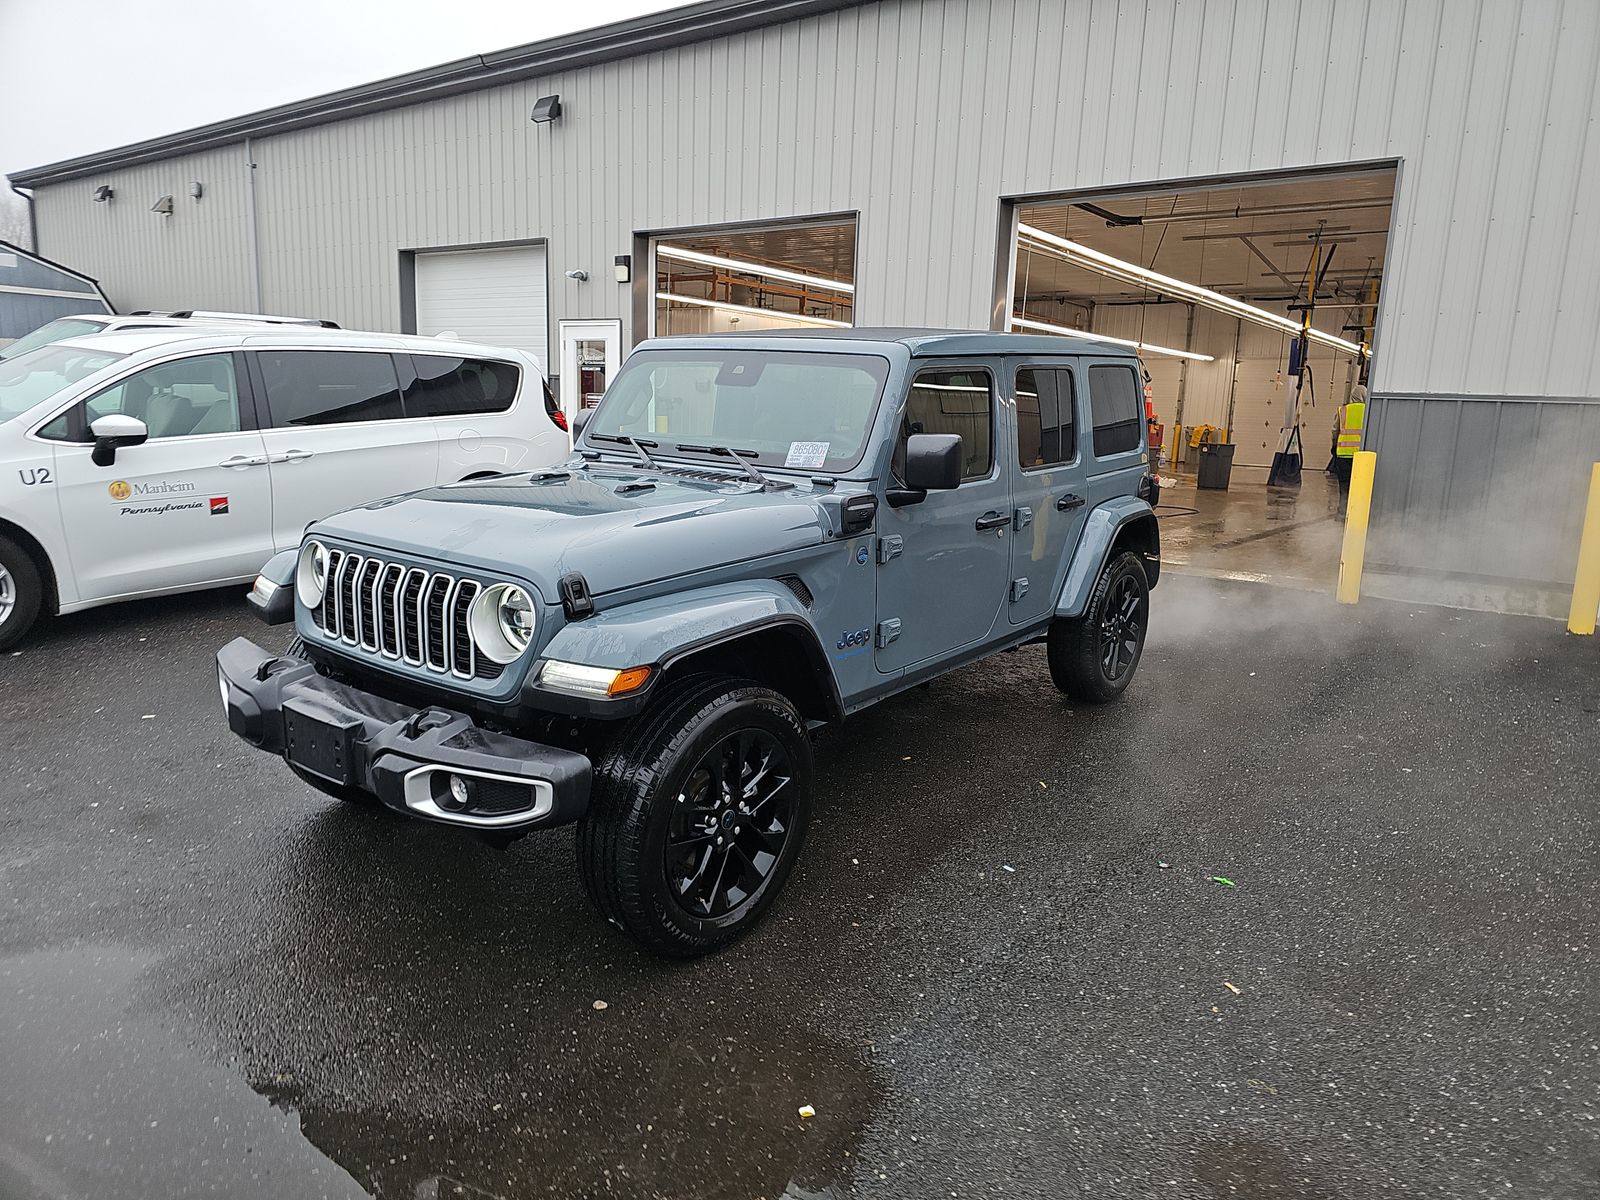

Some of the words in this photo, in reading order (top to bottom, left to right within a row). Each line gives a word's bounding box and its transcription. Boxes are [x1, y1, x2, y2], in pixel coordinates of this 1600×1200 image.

[19, 468, 53, 486] U2
[134, 480, 196, 496] Manheim
[120, 502, 204, 516] Pennsylvania
[837, 628, 871, 650] Jeep
